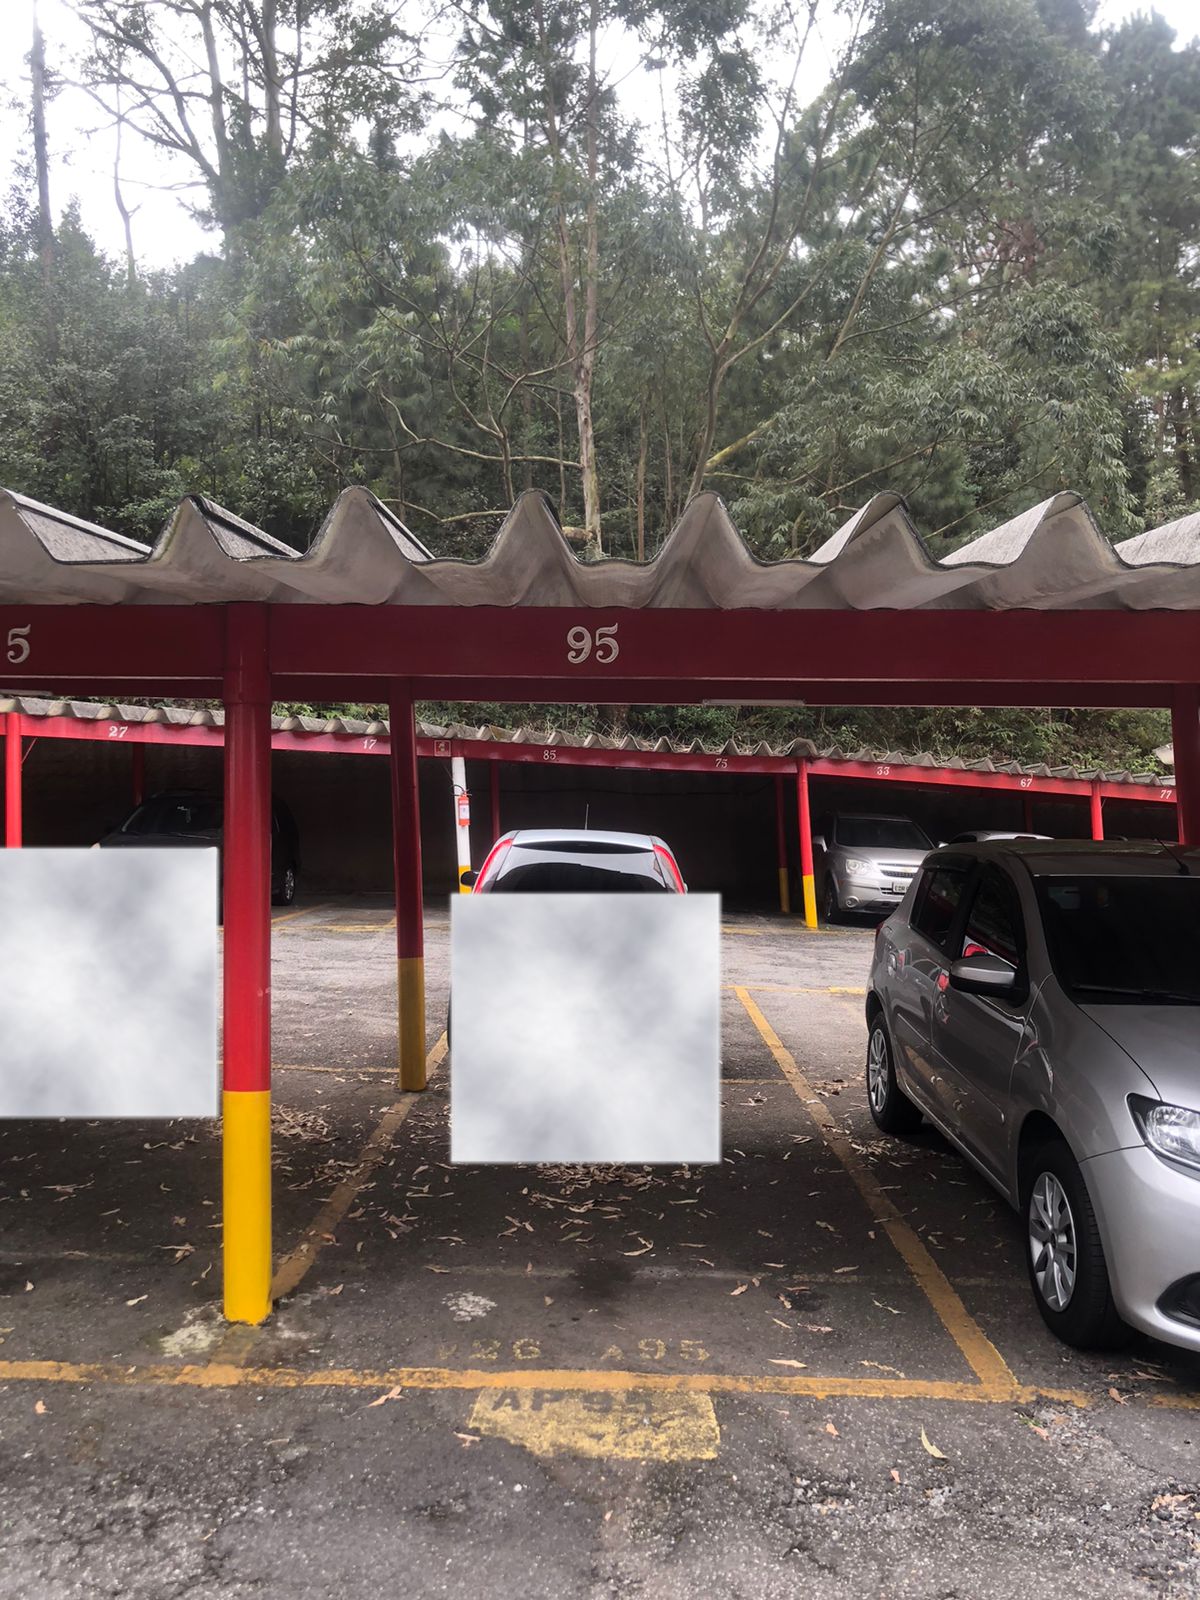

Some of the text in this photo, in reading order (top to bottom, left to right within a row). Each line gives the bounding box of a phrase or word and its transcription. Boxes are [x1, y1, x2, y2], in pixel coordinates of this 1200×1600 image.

[566, 622, 620, 664] 95
[108, 725, 128, 739] 27
[363, 739, 378, 750] 17
[543, 750, 557, 761] 85
[715, 758, 729, 769] 75
[876, 766, 890, 776] 33
[1019, 778, 1033, 788] 67
[1159, 789, 1173, 799] 77
